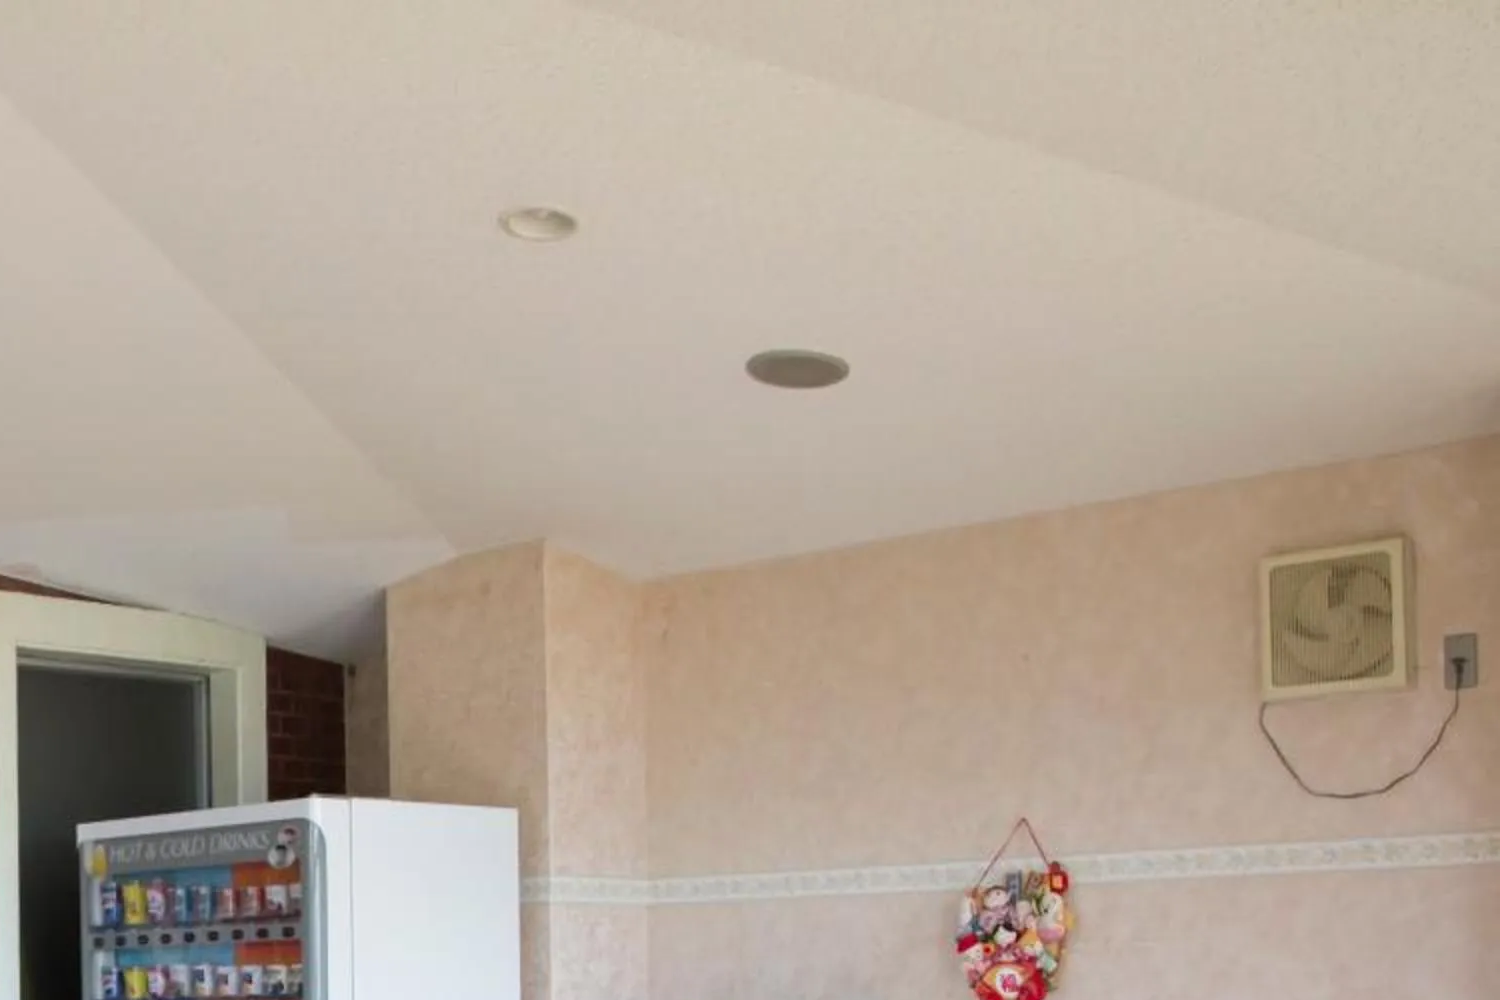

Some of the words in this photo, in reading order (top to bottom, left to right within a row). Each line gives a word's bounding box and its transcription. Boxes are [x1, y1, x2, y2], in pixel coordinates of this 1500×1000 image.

[110, 841, 141, 862] HOT
[160, 838, 206, 859] COLD
[209, 831, 270, 854] DRINKS
